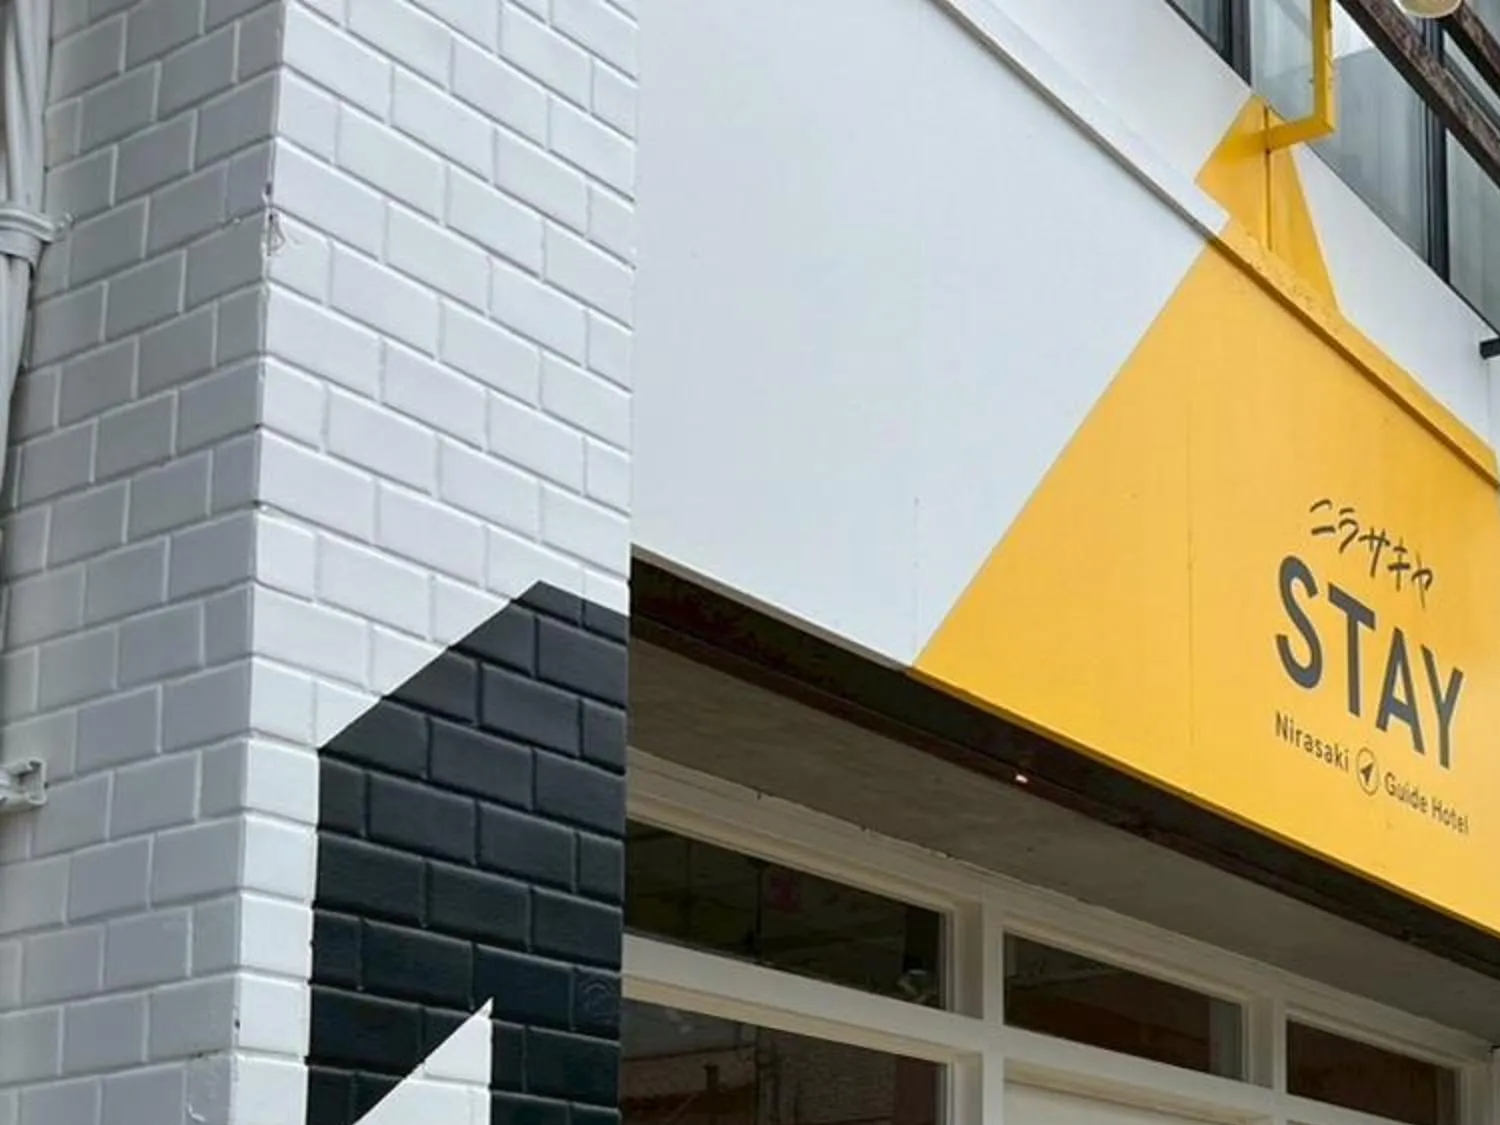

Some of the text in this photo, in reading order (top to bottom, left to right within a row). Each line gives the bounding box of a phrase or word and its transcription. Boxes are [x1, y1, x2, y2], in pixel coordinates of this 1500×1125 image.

[1309, 498, 1433, 609] ニラサキヤ
[1276, 555, 1464, 770] STAY
[1274, 711, 1469, 835] Nirasaki Guide Hotel
